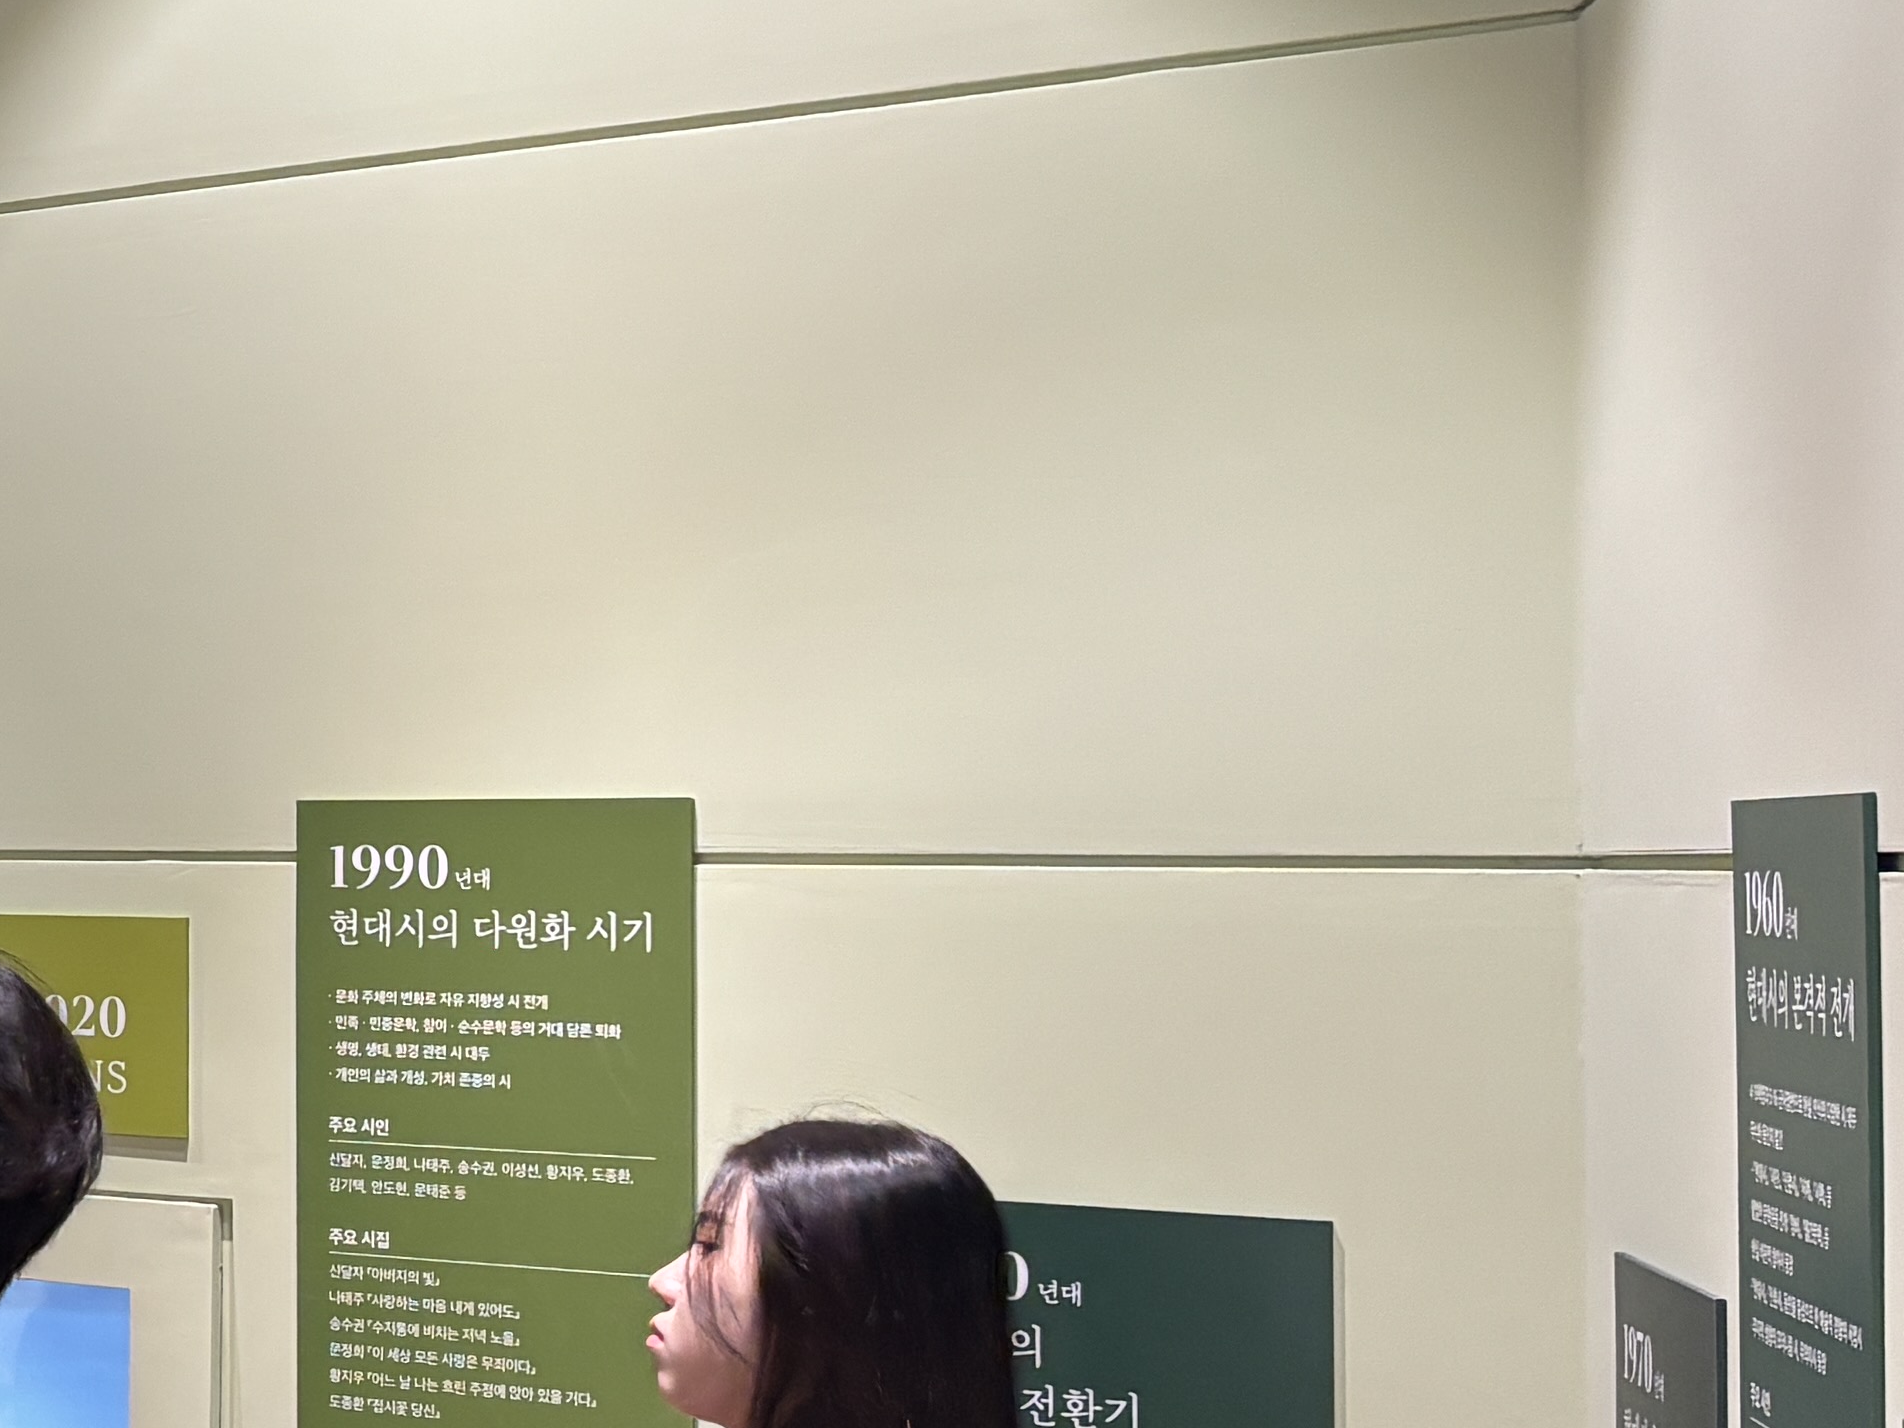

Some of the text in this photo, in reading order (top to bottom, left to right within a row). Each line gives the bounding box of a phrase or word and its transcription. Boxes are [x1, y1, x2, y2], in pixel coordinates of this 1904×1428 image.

[330, 844, 491, 891] 1990 년대
[1744, 870, 1784, 937] 1960
[329, 907, 653, 953] 현대시의 다원화 시기
[335, 988, 548, 1010] 문화 주체의 변화로 자유 지향성 시 전개
[1747, 966, 1855, 1042] 현대시의 본격적 전개
[334, 1040, 490, 1061] 생명, 생태, 환경 관련 시 대두
[334, 1066, 511, 1089] 개인의 삶과 개성, 가치 존중의 시
[328, 1115, 389, 1136] 주요 시인
[328, 1227, 390, 1249] 주요 시집
[1038, 1281, 1082, 1307] 년대
[1624, 1324, 1652, 1393] 1970
